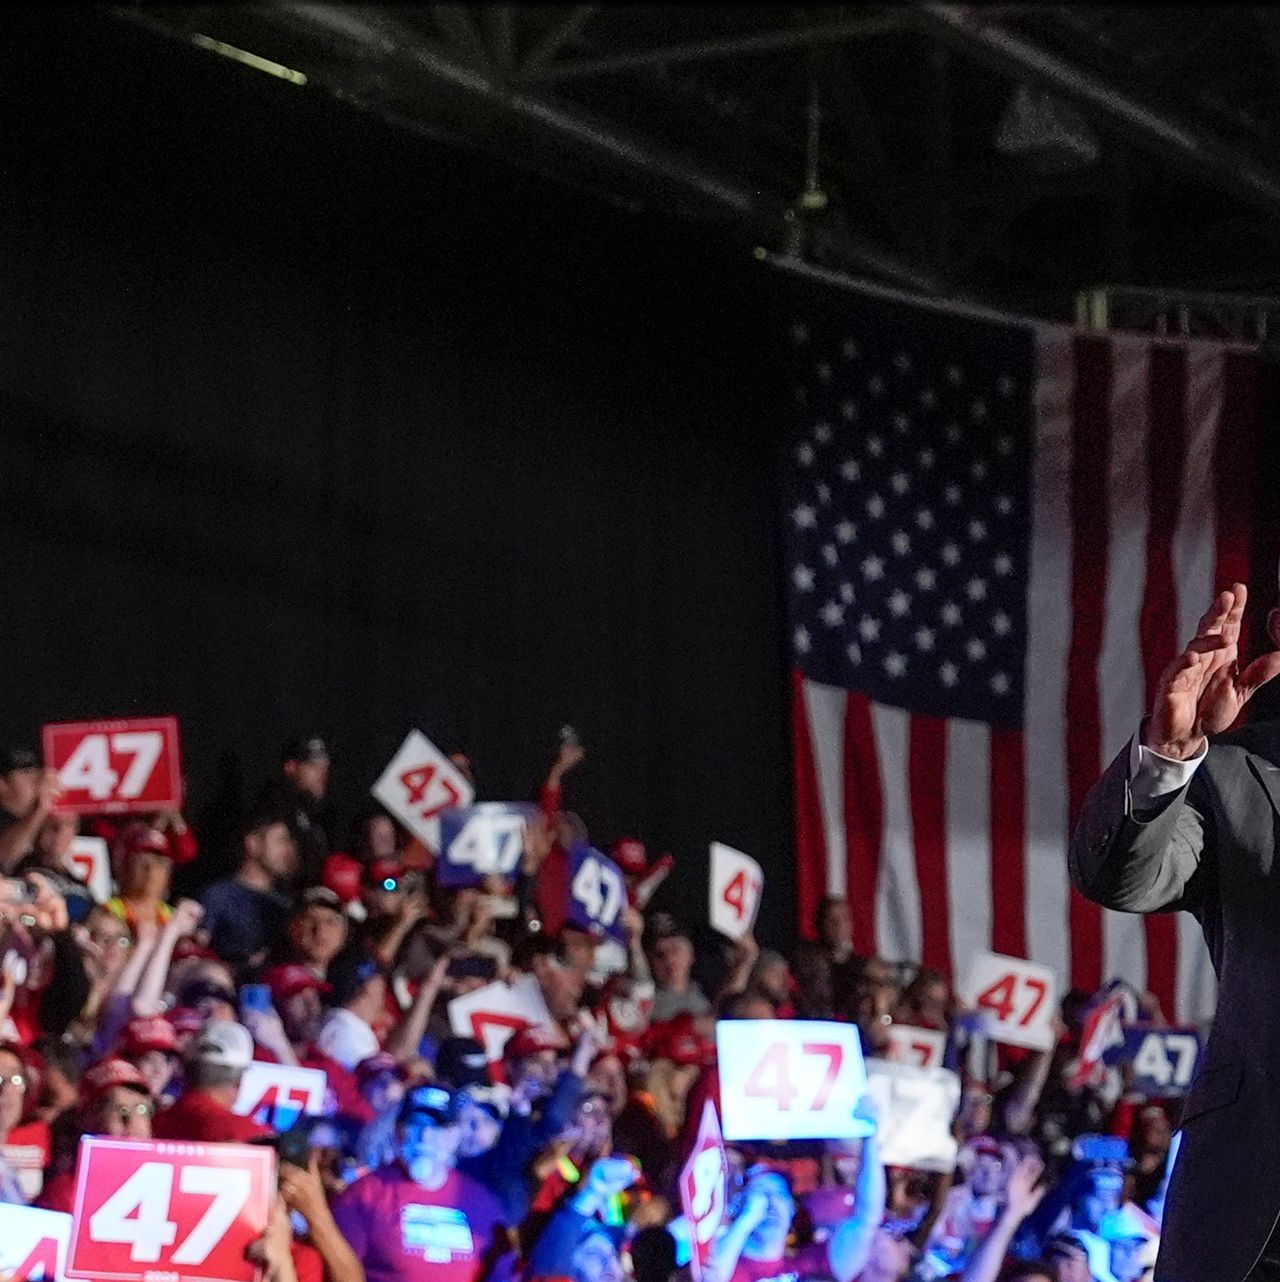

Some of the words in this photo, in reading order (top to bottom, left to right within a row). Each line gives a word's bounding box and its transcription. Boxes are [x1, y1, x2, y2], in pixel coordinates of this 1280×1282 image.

[57, 731, 163, 798] 47
[399, 765, 461, 818] 47
[447, 812, 524, 874] 47
[572, 863, 625, 927] 47
[978, 972, 1048, 1026] 47
[744, 1043, 843, 1111] 47
[1133, 1034, 1197, 1085] 47
[89, 1161, 252, 1265] 47
